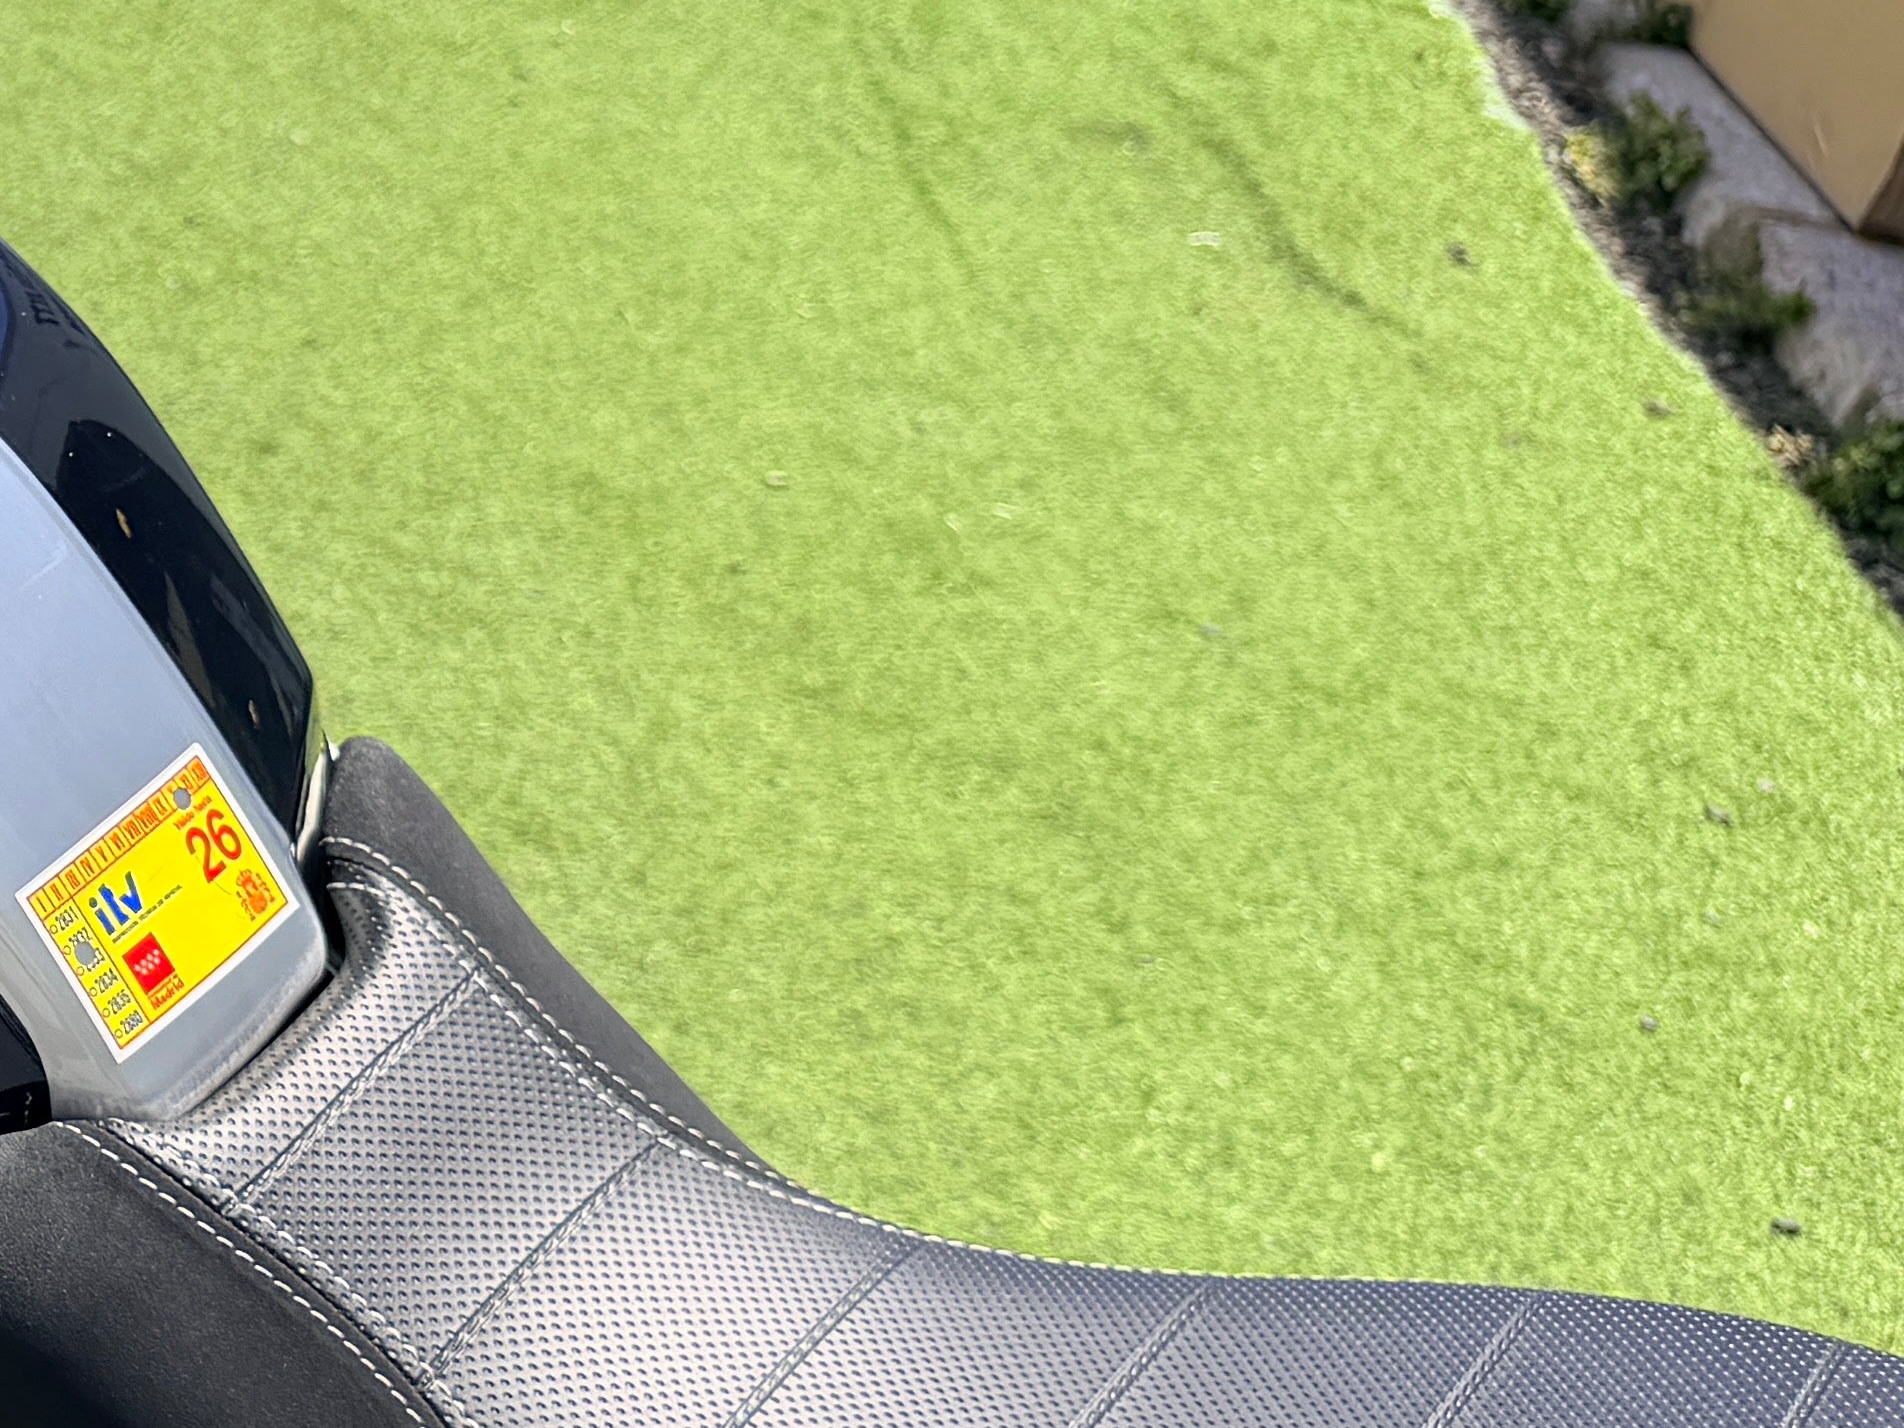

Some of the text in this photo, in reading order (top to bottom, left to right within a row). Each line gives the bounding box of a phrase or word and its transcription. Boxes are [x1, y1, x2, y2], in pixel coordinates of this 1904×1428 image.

[185, 808, 242, 884] 26
[89, 871, 143, 936] itv
[152, 979, 185, 1011] Madrid
